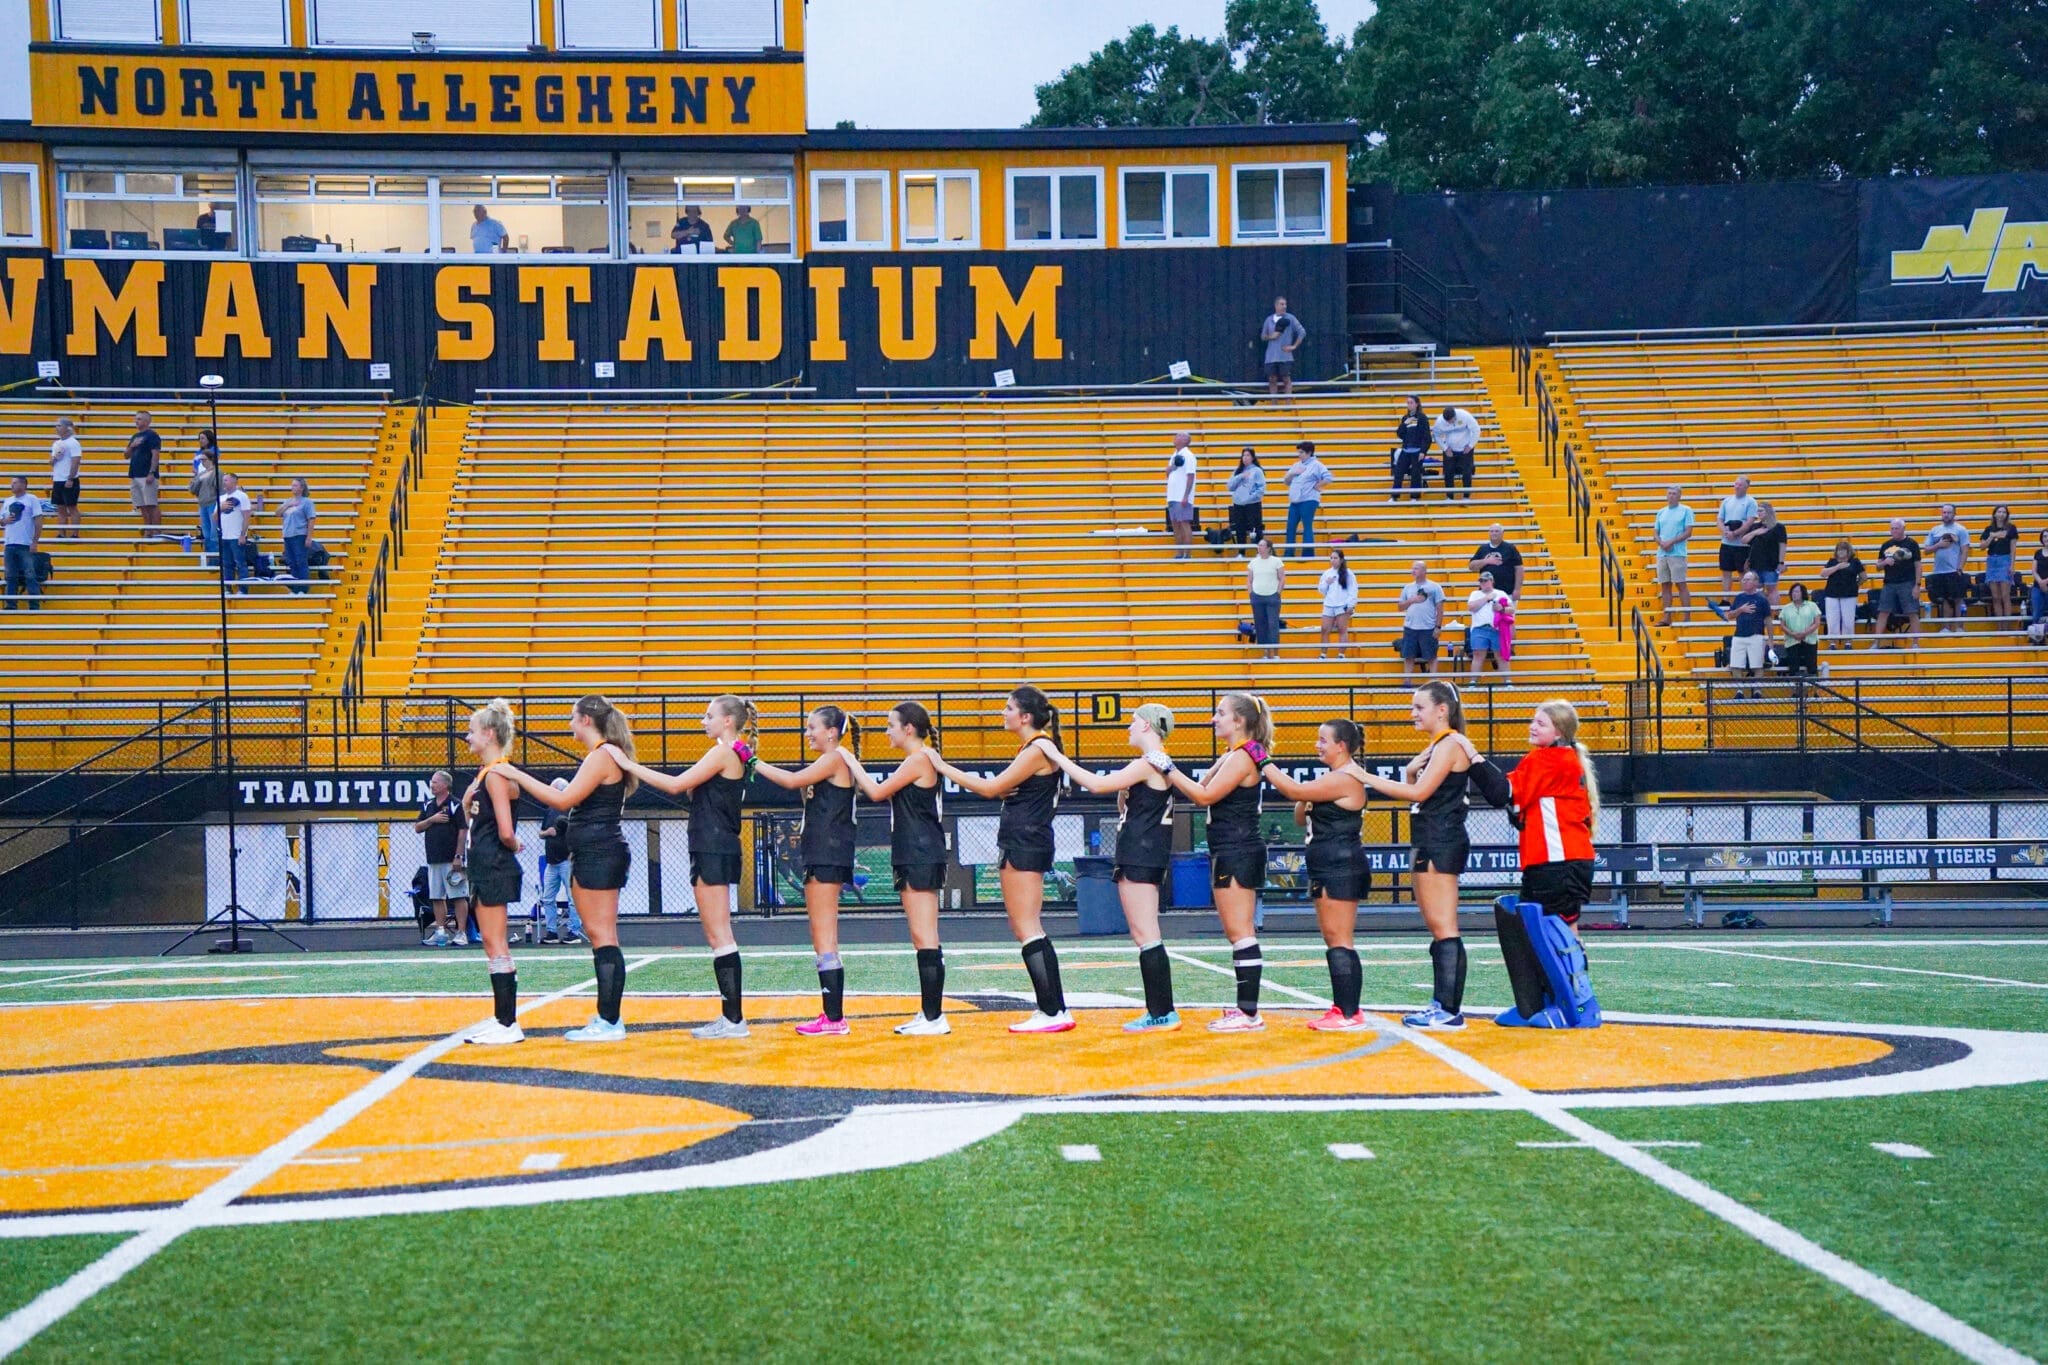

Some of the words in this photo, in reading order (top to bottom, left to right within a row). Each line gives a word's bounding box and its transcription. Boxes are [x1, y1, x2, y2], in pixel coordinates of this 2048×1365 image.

[78, 66, 318, 120] NORTH
[348, 72, 757, 124] ALLEGHENY
[435, 266, 1063, 361] STADIUM
[1097, 696, 1115, 719] D
[239, 780, 436, 804] TRADITION
[1491, 853, 1520, 868] TIG
[1766, 850, 1824, 866] NORTH
[1829, 849, 1929, 866] ALLEGHENY
[1935, 848, 1997, 864] TIGERS
